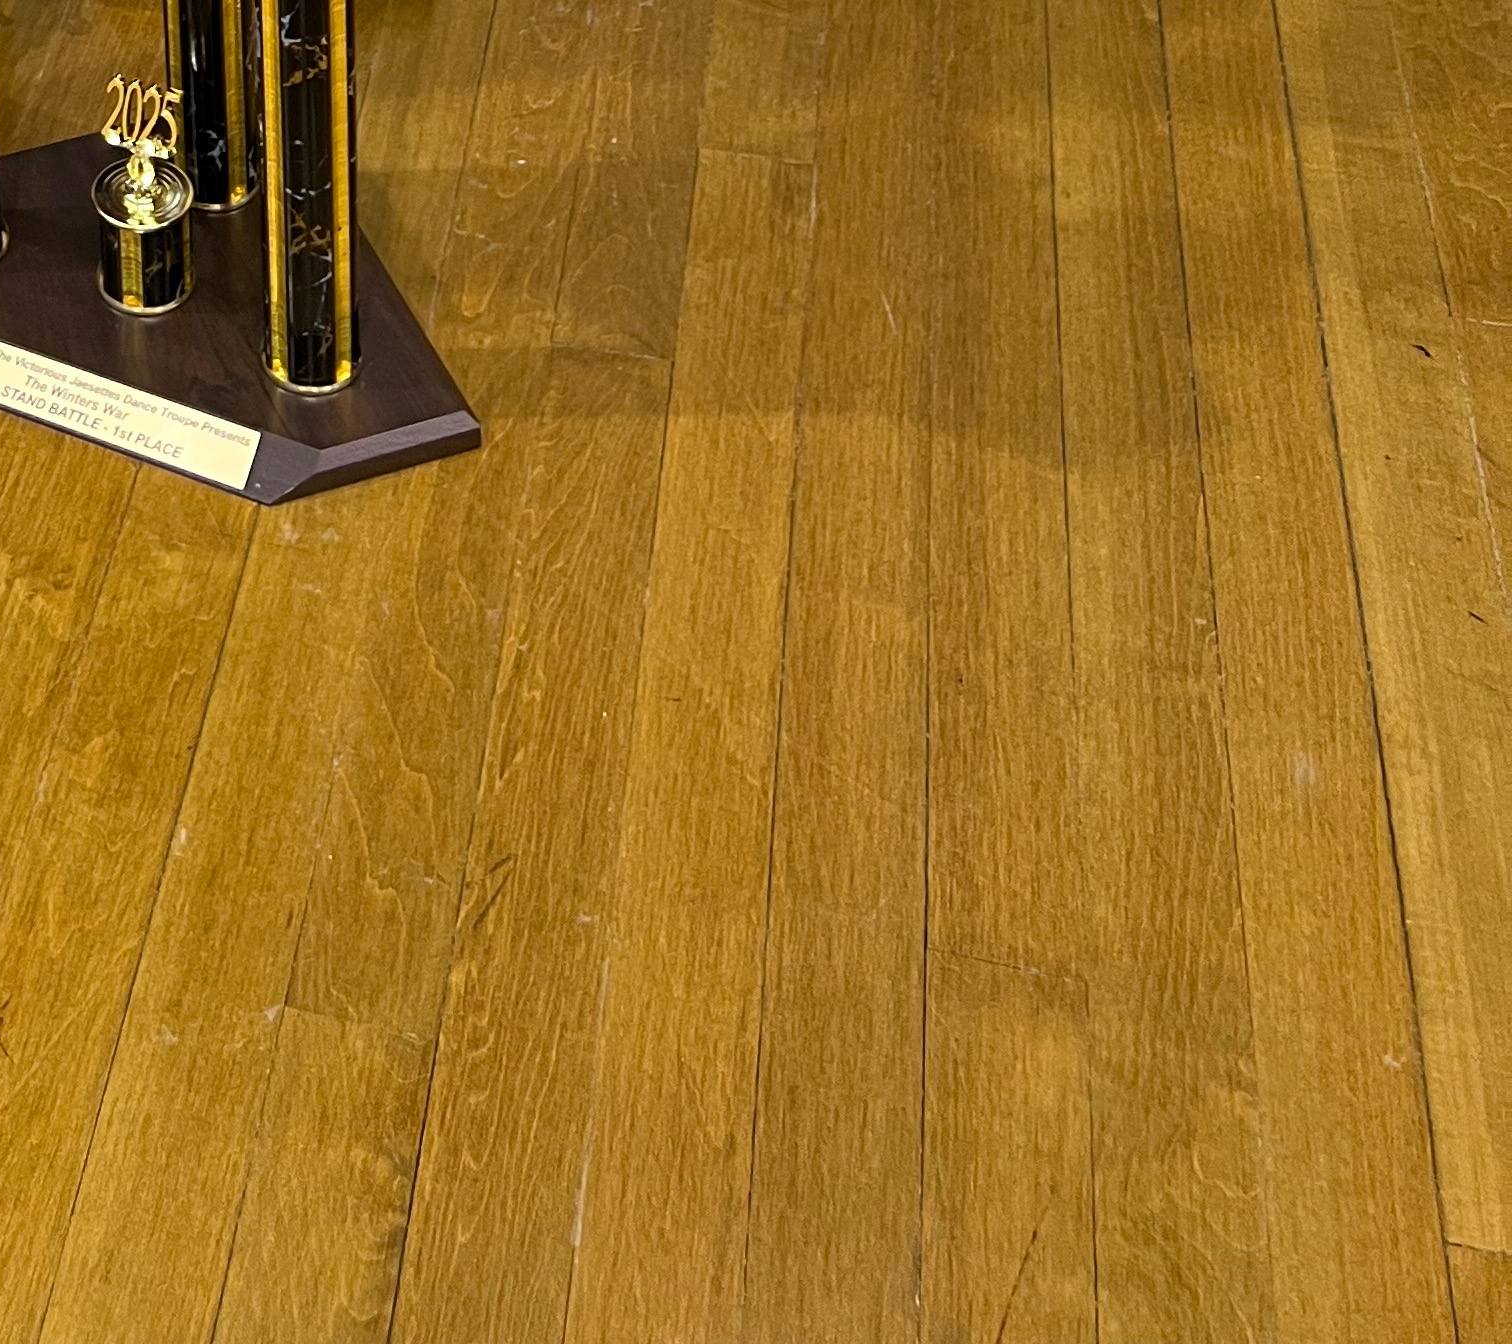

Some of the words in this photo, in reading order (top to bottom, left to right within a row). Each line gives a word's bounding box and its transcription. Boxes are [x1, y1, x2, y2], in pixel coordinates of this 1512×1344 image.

[101, 74, 183, 160] 2025
[1, 385, 46, 410] STAND
[48, 402, 103, 431] BATTLE
[112, 425, 133, 442] 1st
[134, 432, 185, 459] PLACE
[16, 356, 67, 382] Victorious
[123, 394, 158, 414] Dance
[201, 421, 251, 447] Presents
[25, 374, 48, 393] The
[51, 384, 100, 411] Winters
[103, 402, 130, 421] War
